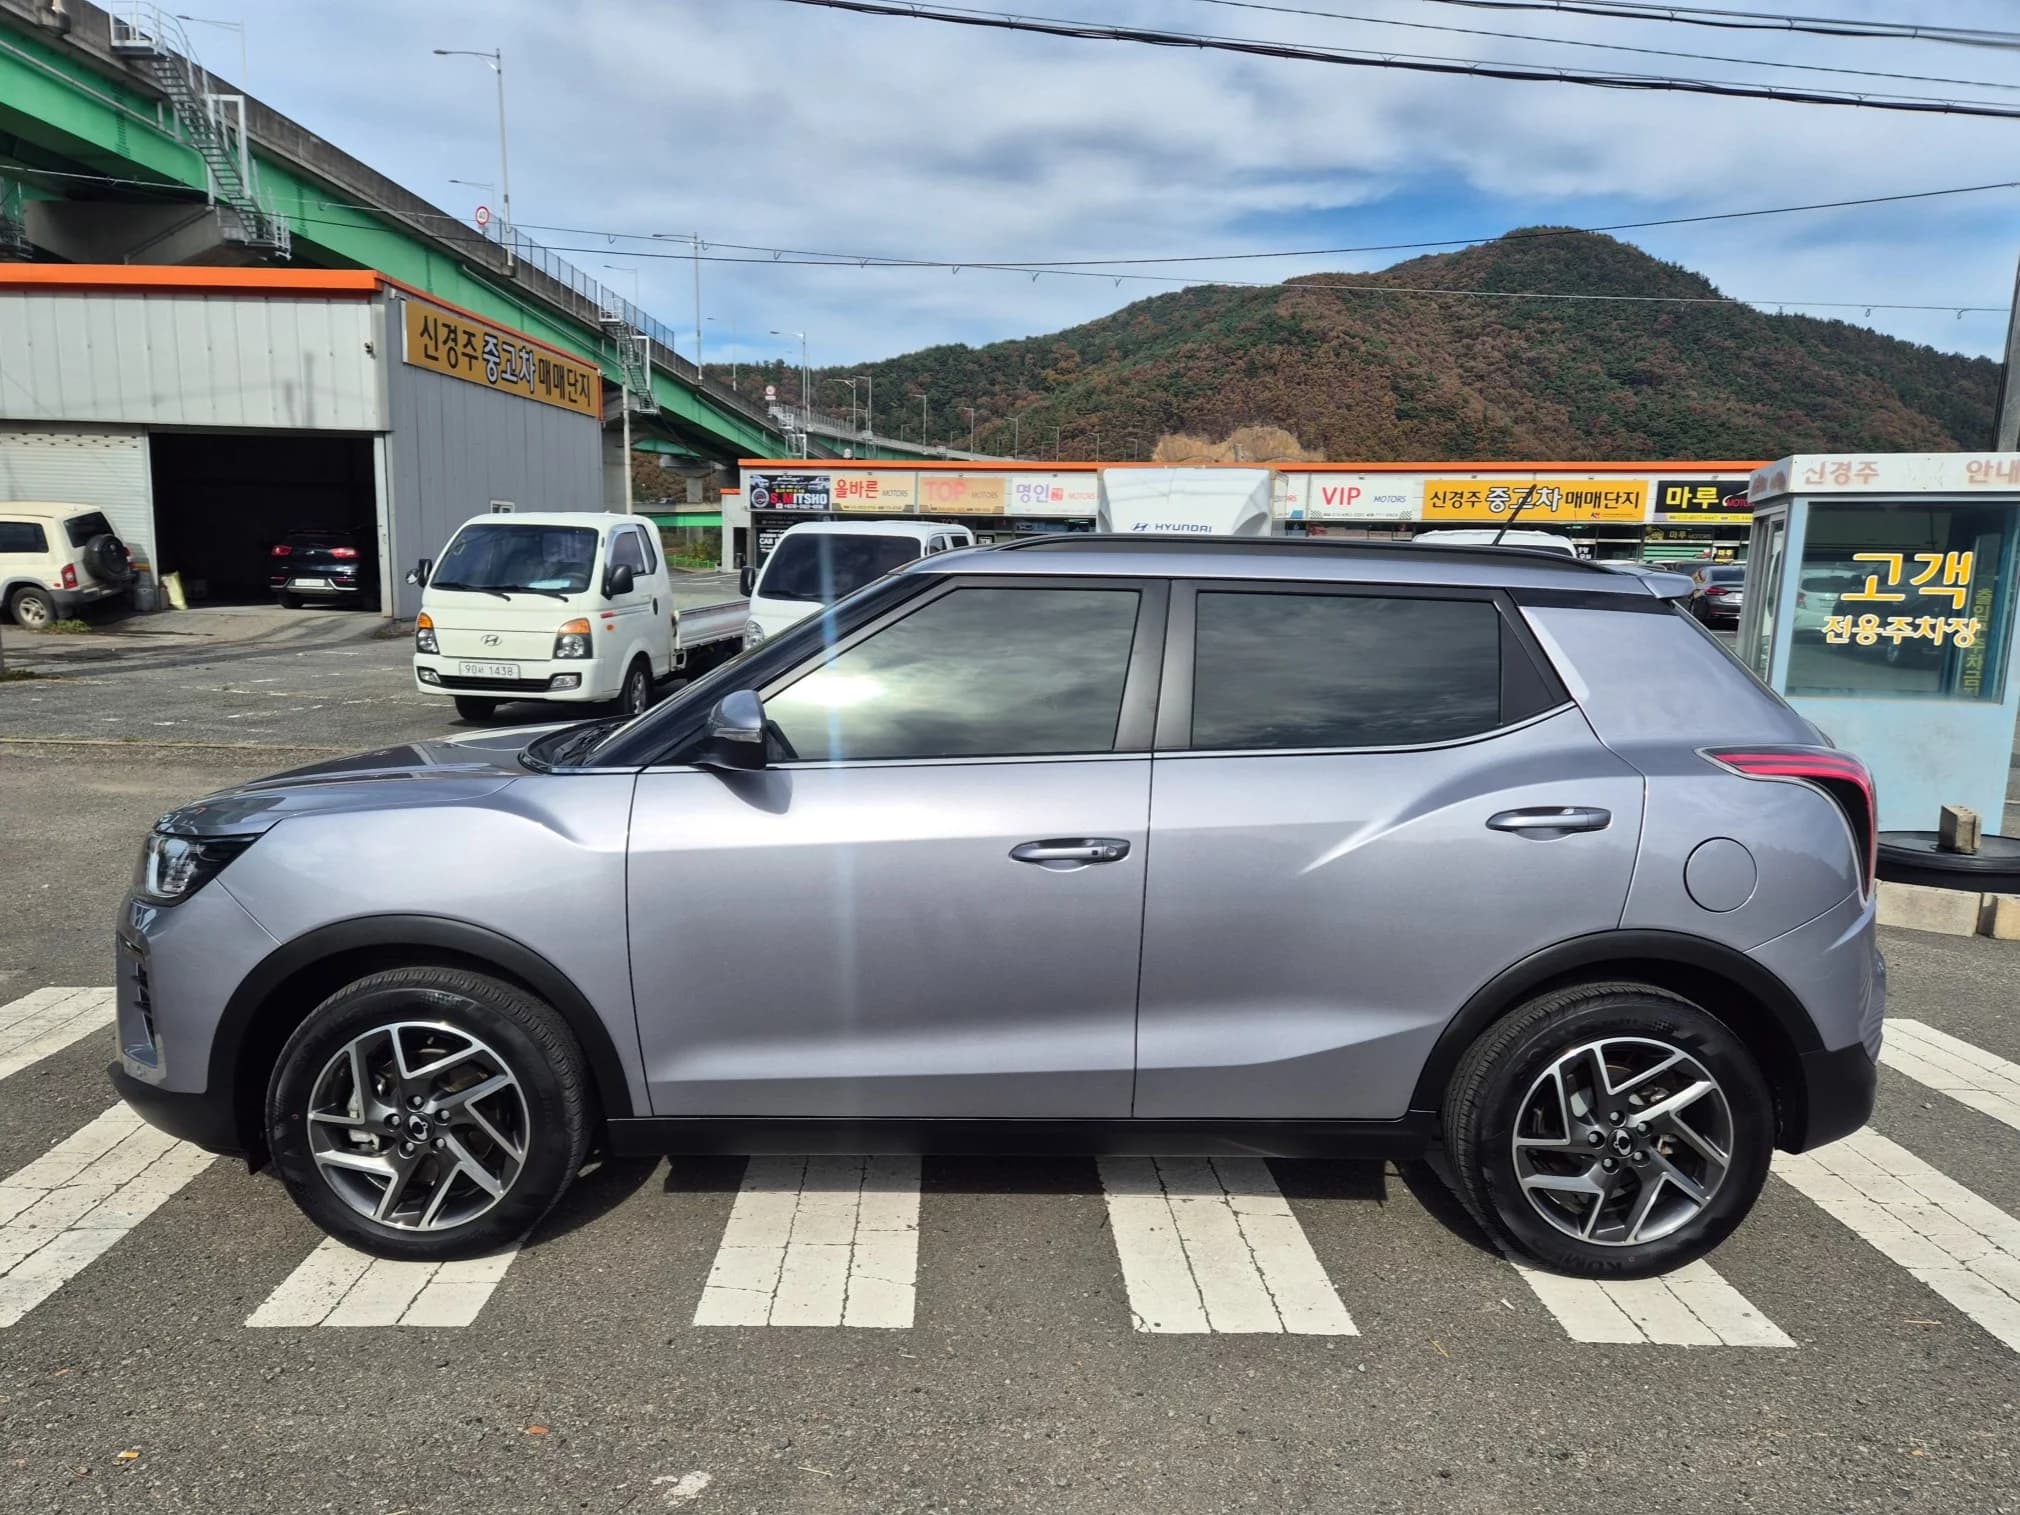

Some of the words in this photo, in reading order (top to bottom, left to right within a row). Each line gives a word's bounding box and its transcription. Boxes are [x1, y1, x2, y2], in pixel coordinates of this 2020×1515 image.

[419, 315, 479, 371] 신경주
[482, 332, 536, 395] 중고차
[538, 357, 591, 407] 매매단지
[1804, 461, 1880, 486] 신경주
[834, 479, 879, 499] 올바른
[882, 489, 909, 498] MOTORS
[924, 480, 967, 501] TOP
[1016, 483, 1049, 504] 명인
[1322, 486, 1362, 506] VIP
[1373, 495, 1407, 503] MOTORS
[1430, 491, 1482, 509] 신경주
[1486, 486, 1562, 513] 중고차
[1565, 491, 1639, 510] 매매단지
[1665, 486, 1719, 509] 마루
[1155, 523, 1212, 533] HYUNDAI
[1840, 551, 1975, 610] 고객
[1821, 614, 1982, 648] 전용주차장
[489, 666, 513, 676] 1438
